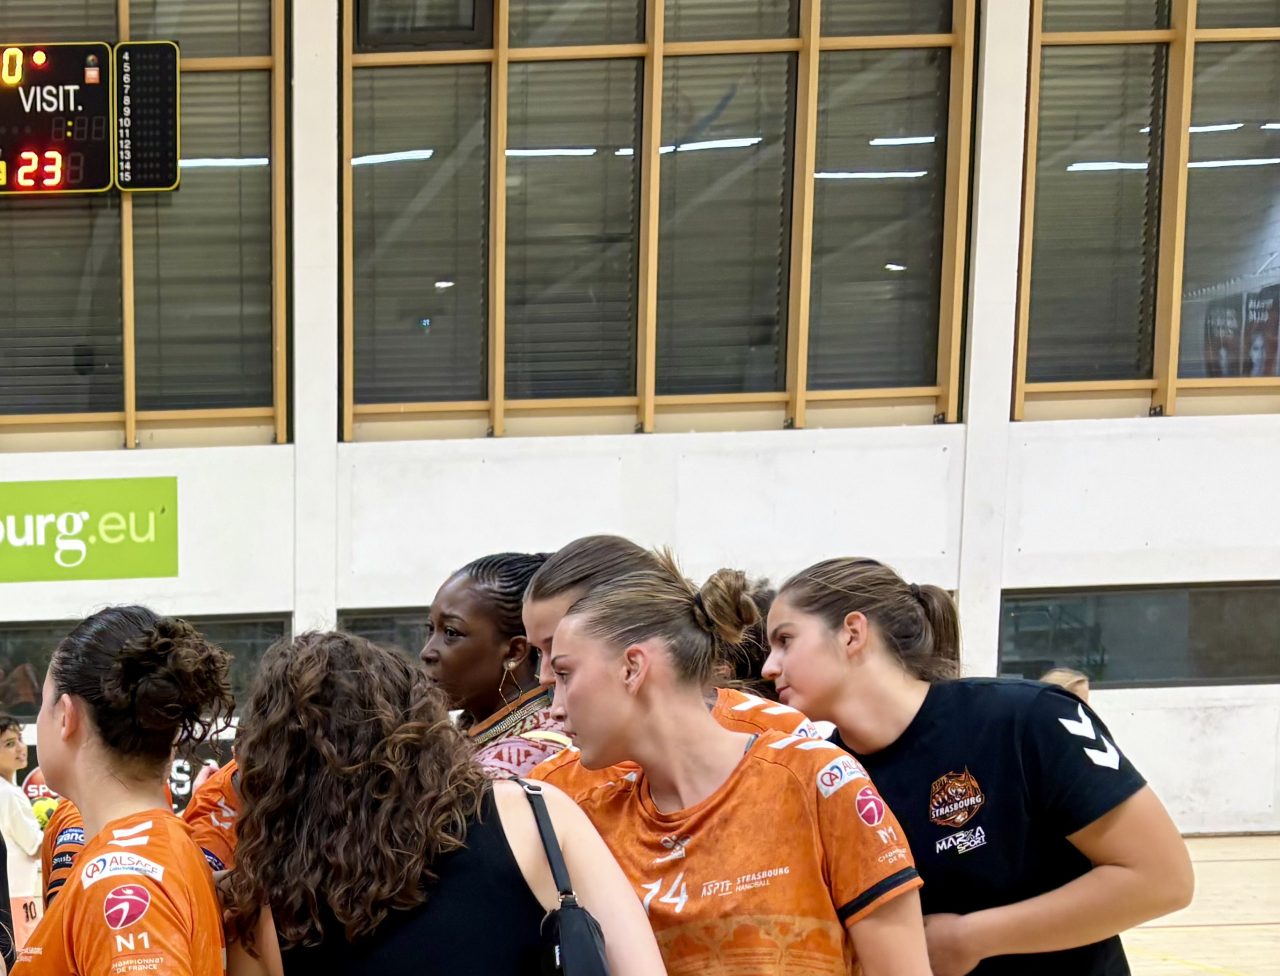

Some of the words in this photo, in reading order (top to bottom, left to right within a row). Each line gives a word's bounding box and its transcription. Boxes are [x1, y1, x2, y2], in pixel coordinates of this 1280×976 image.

[122, 51, 129, 60] 4
[123, 63, 130, 72] 5
[123, 74, 130, 83] 6
[123, 85, 130, 94] 7
[18, 85, 83, 113] VISIT.
[123, 96, 130, 105] 8
[123, 107, 131, 116] 9
[119, 118, 131, 127] 10
[119, 129, 129, 138] 11
[119, 140, 131, 149] 12
[120, 150, 131, 159] 13
[17, 151, 62, 186] 23
[120, 161, 131, 170] 14
[120, 172, 131, 181] 15
[27, 784, 59, 798] SP
[931, 795, 982, 819] STRASBOURG
[736, 866, 790, 883] STRASBOURG
[115, 931, 151, 953] N1
